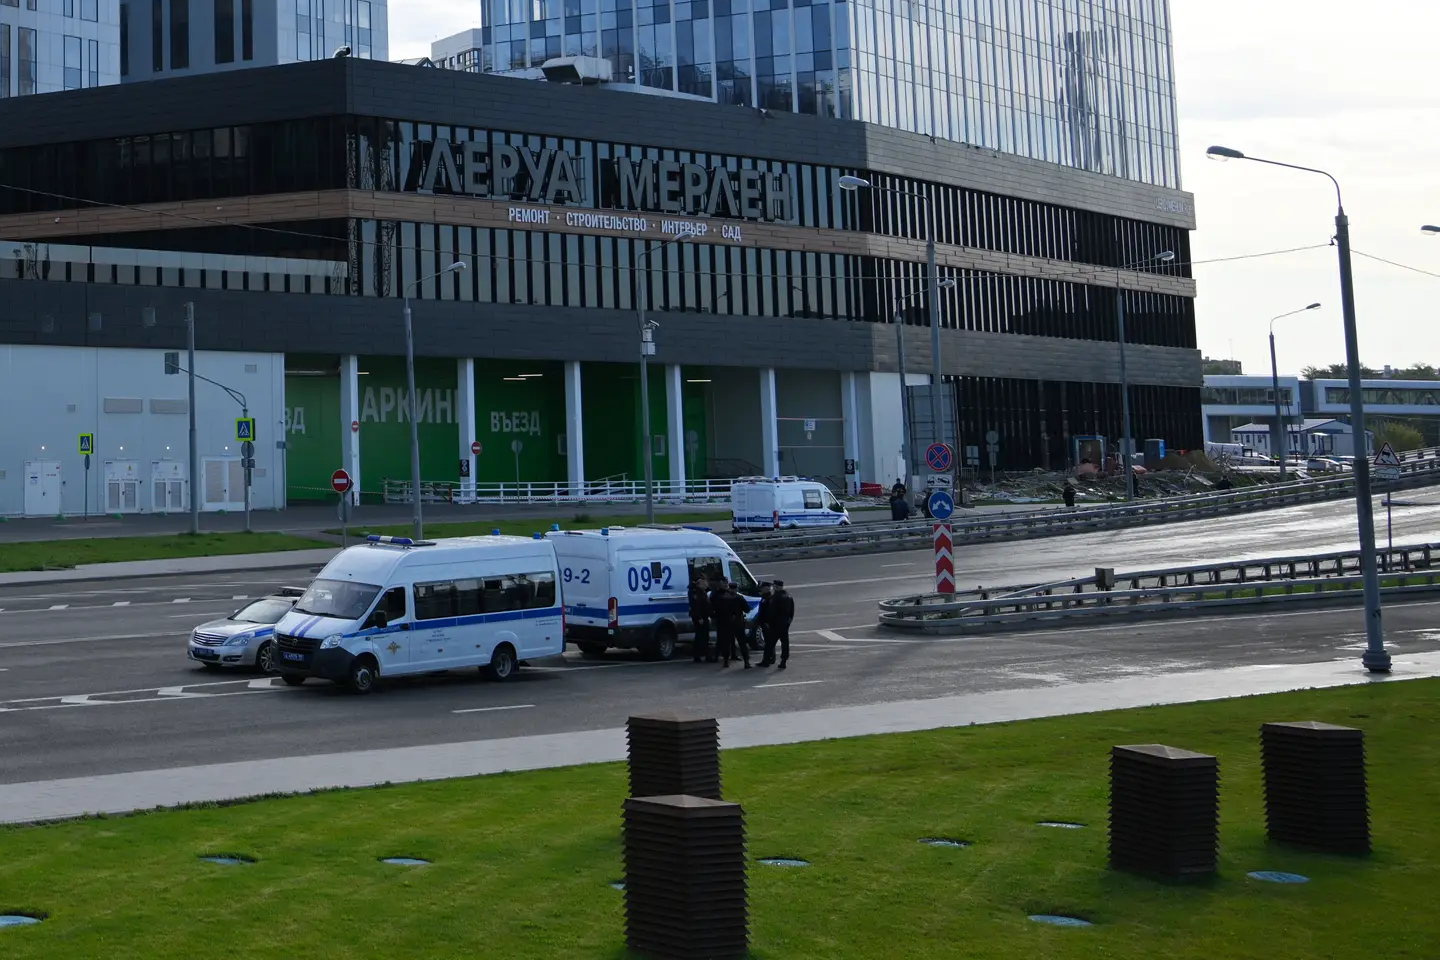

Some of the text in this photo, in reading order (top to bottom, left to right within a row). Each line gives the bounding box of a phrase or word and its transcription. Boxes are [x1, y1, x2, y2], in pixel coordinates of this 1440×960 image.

[508, 207, 742, 242] РЕМОНТ СТРОИТЕЛЬСТВО ИНТЕРЬЕР САД
[360, 386, 459, 424] АРКИН
[490, 410, 541, 436] ВЪЕЗД
[559, 567, 590, 584] 9-2
[628, 566, 673, 592] 09-2
